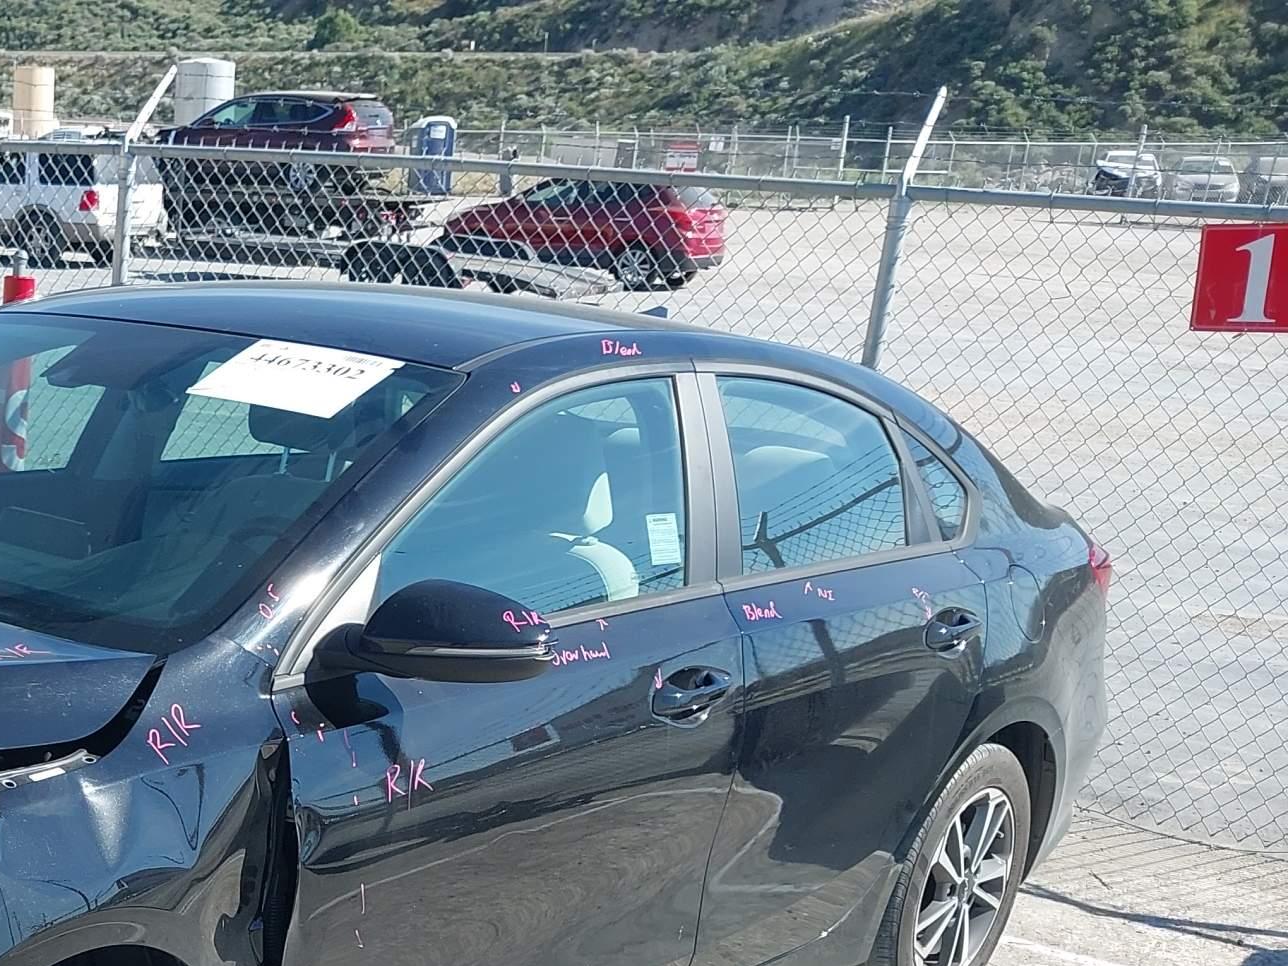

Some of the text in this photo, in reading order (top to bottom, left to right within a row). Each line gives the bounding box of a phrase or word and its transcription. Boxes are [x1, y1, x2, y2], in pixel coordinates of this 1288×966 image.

[1225, 233, 1277, 323] 1
[250, 352, 366, 380] 44673302
[742, 601, 784, 621] Blend
[146, 702, 201, 766] R/R
